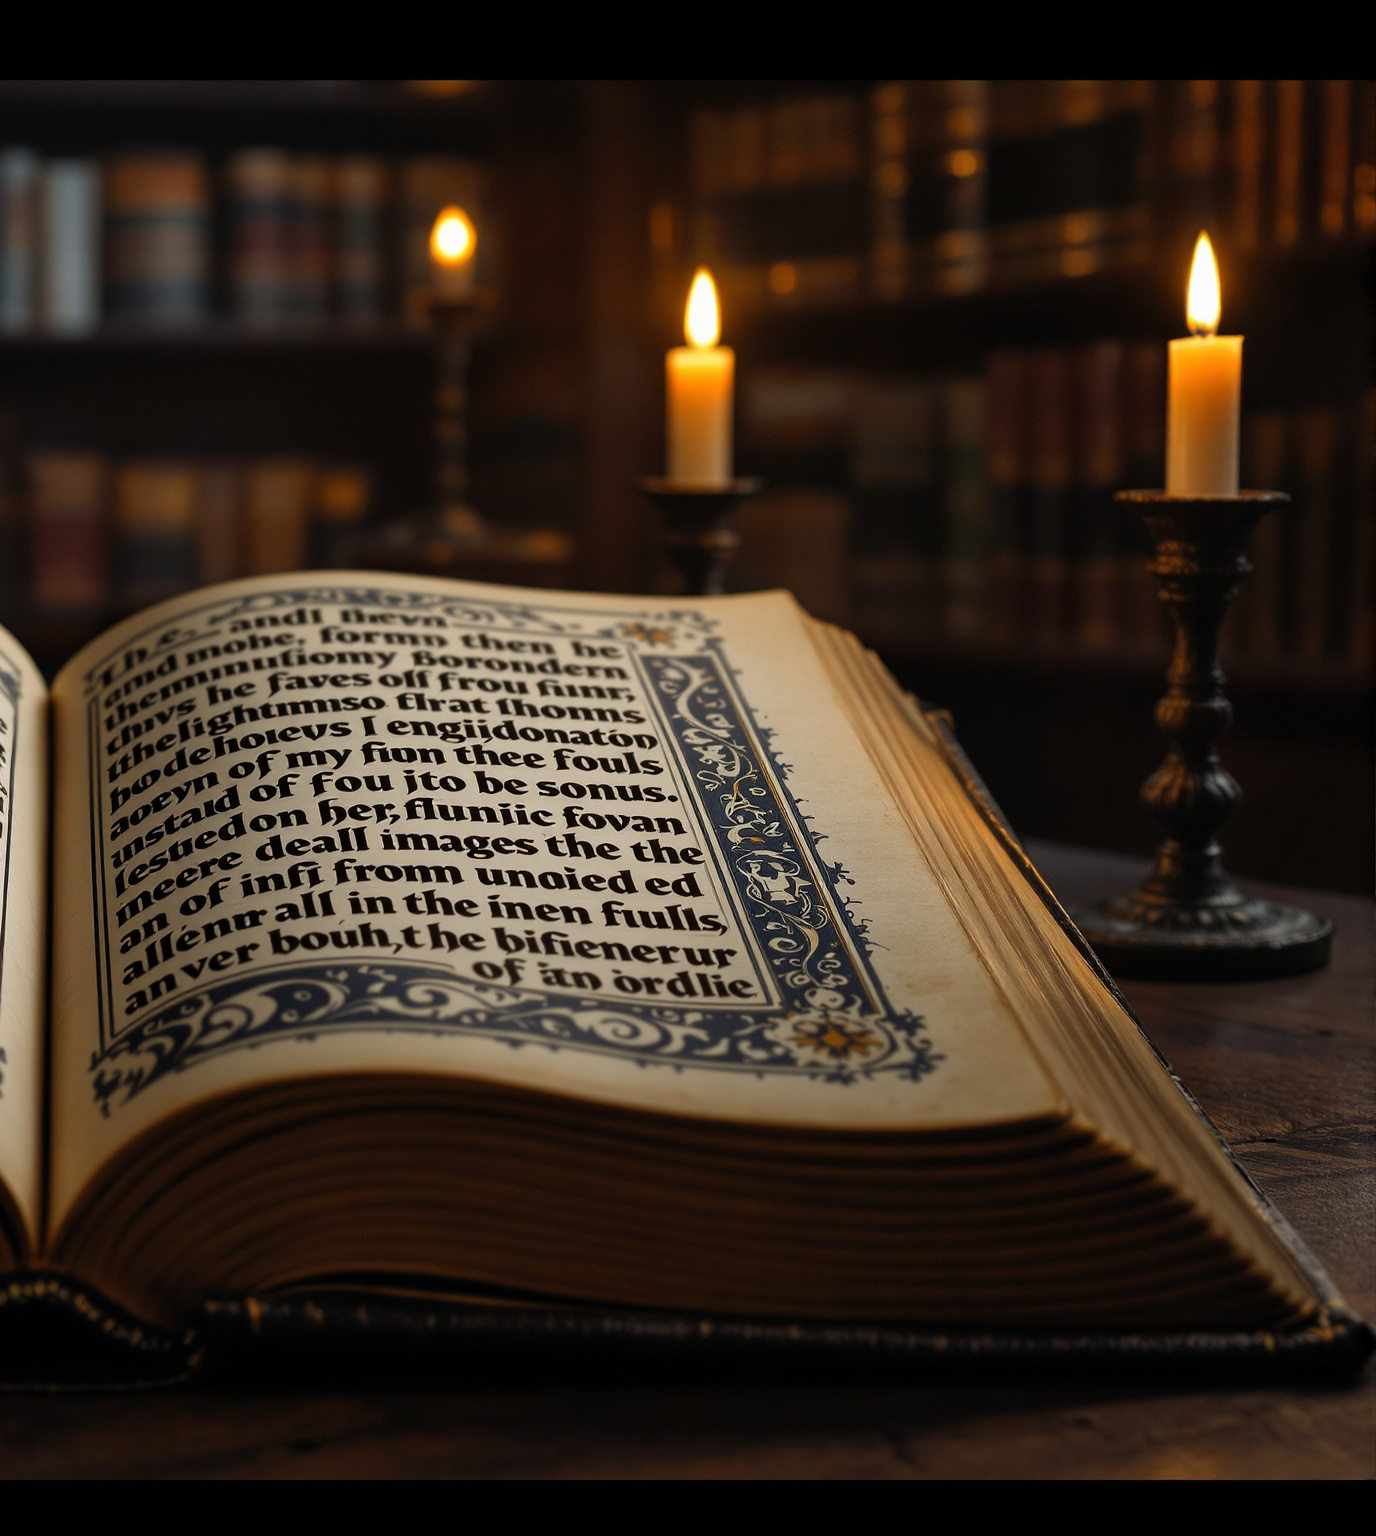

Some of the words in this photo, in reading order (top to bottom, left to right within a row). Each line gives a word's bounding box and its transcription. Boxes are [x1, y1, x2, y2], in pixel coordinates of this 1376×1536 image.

[461, 633, 555, 654] then
[207, 681, 256, 706] he
[267, 672, 372, 697] faves
[229, 749, 291, 780] of
[285, 750, 352, 769] my
[453, 744, 546, 769] thee
[553, 748, 663, 774] fouls
[249, 774, 300, 801] of
[309, 771, 394, 797] fou
[473, 770, 529, 795] be
[536, 781, 678, 802] sonus.
[562, 806, 687, 835] fovan
[380, 829, 539, 859] images
[545, 833, 622, 860] the
[630, 838, 705, 865] the
[120, 912, 170, 954] an
[180, 877, 232, 916] of
[645, 872, 704, 897] ed
[275, 890, 335, 922] all
[347, 891, 397, 914] in
[403, 889, 481, 917] the
[125, 972, 177, 1015] an
[180, 943, 260, 980] ver
[473, 958, 526, 986] of
